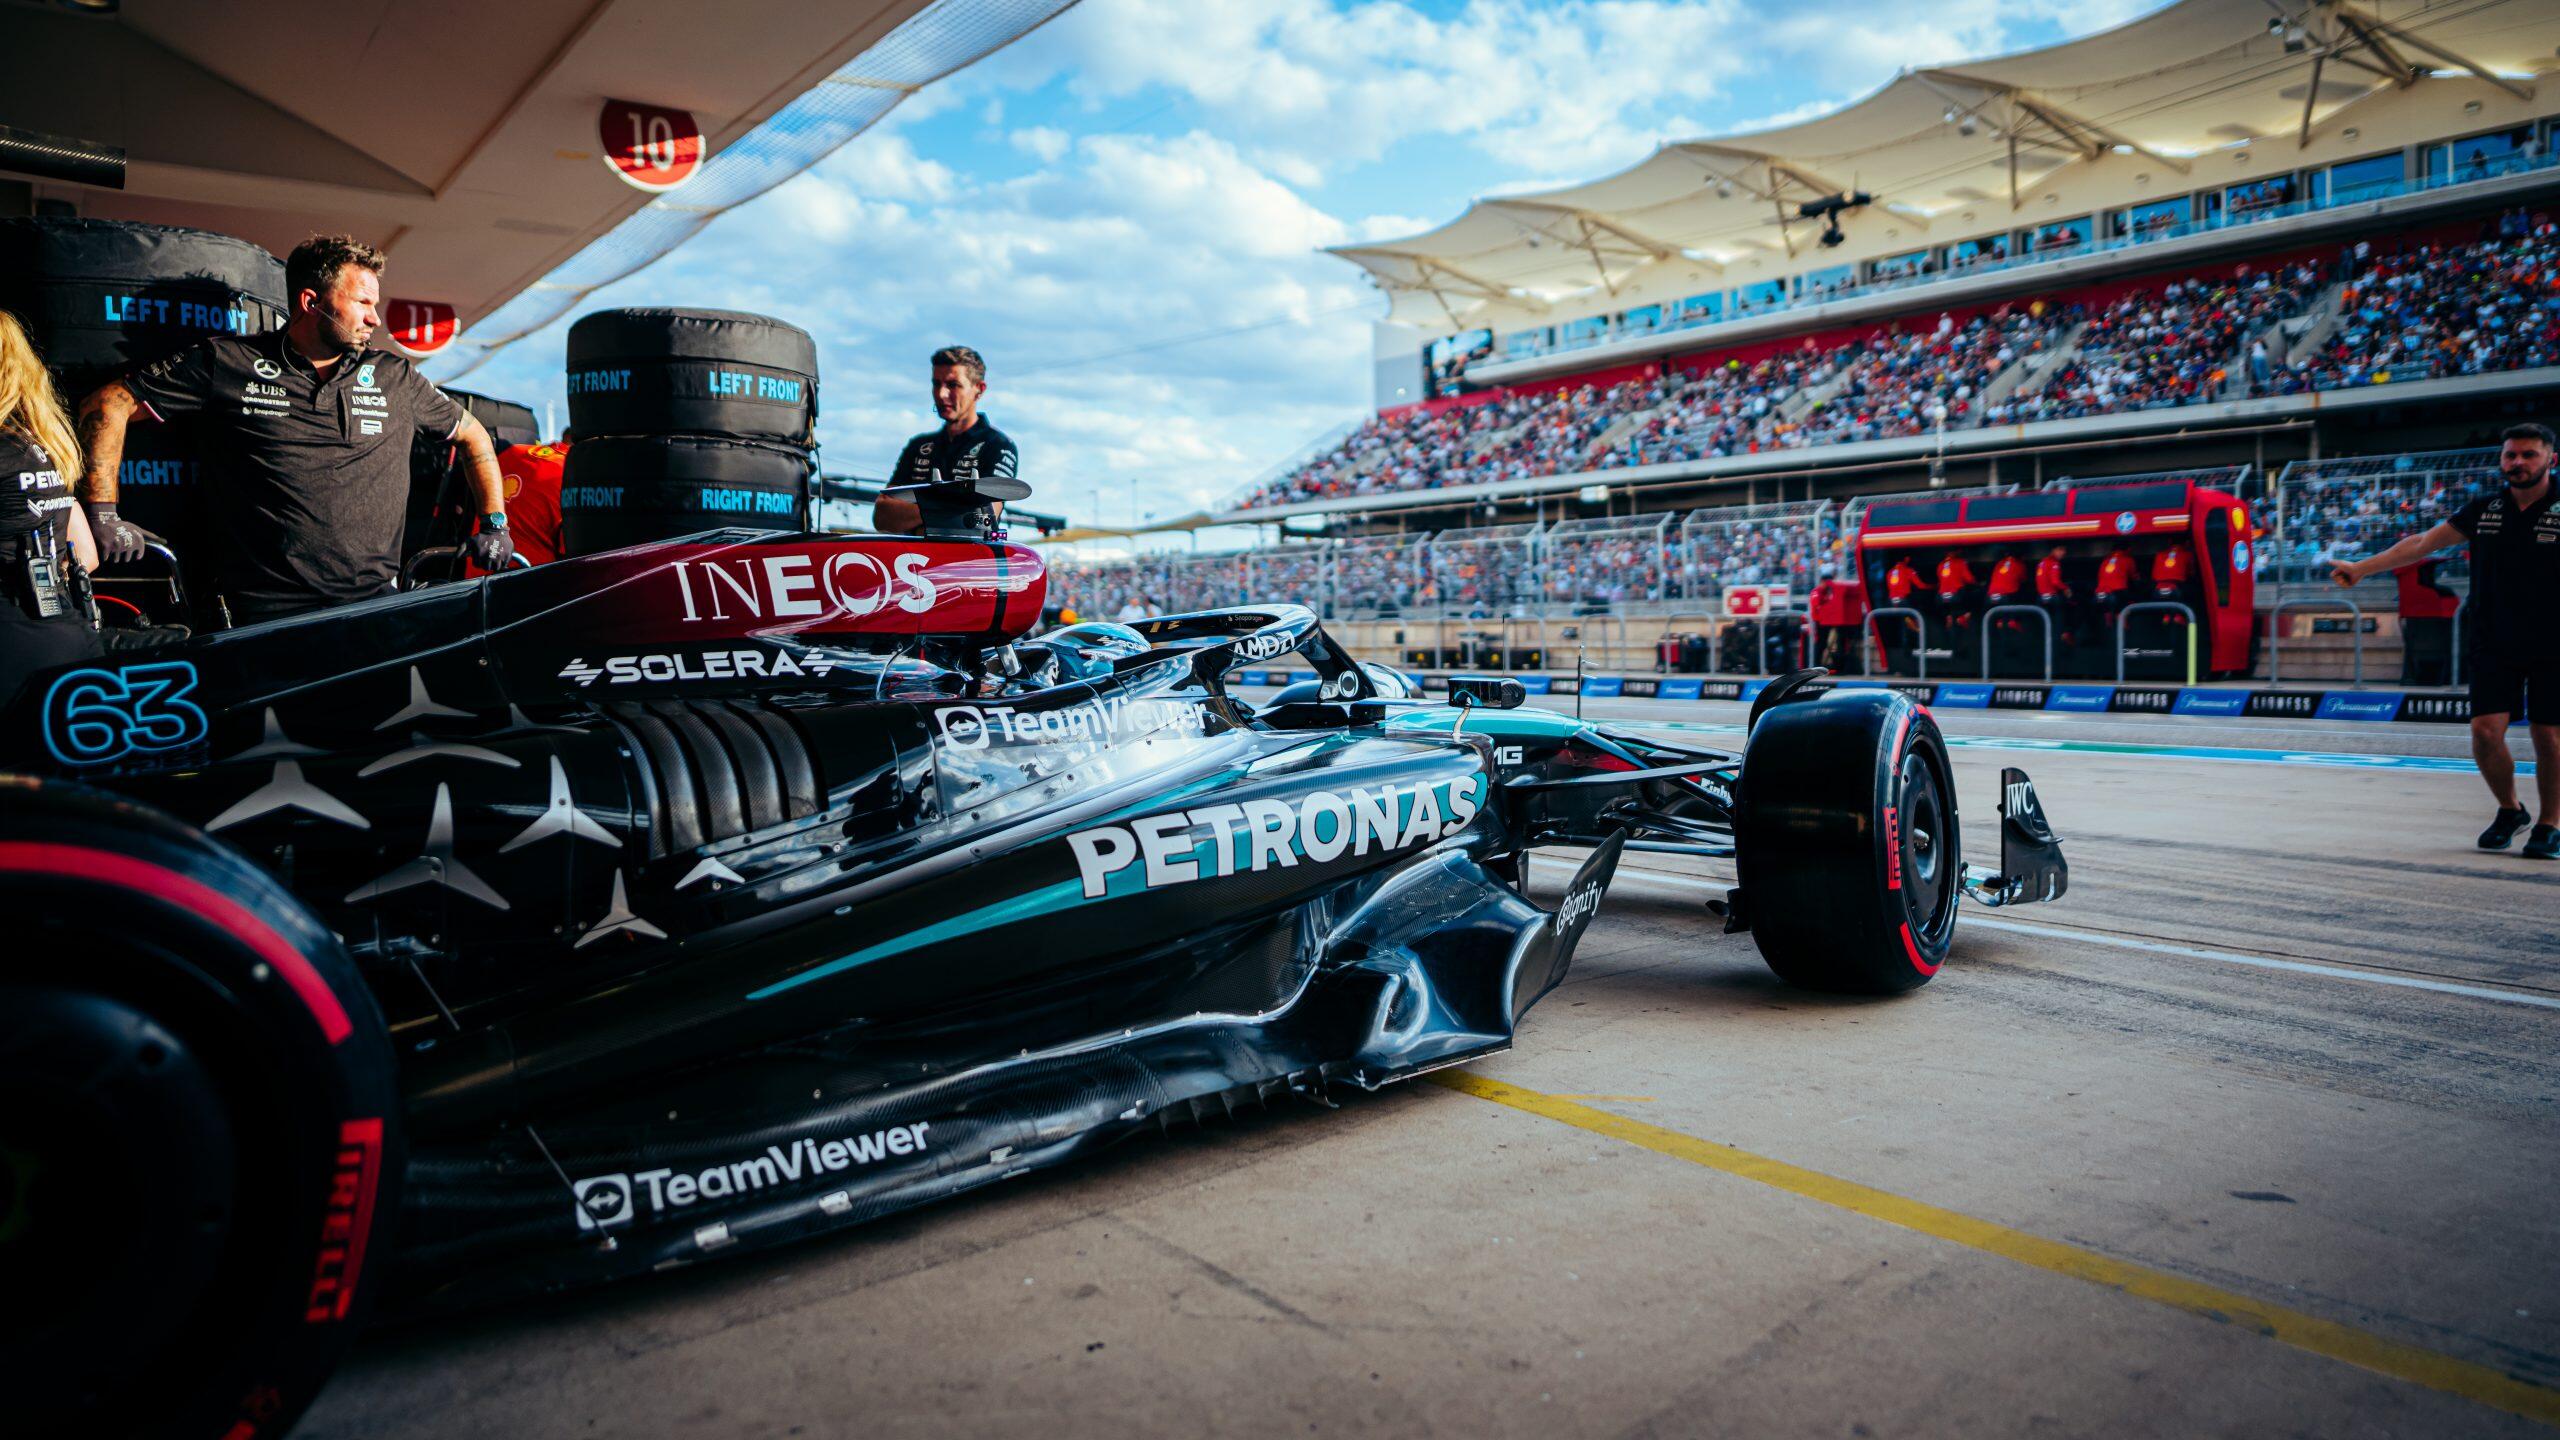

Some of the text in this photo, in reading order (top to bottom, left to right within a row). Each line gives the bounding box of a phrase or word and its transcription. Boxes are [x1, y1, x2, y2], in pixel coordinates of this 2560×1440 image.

[628, 112, 675, 172] 10
[105, 295, 248, 336] LEFT FRONT
[407, 304, 434, 343] 11
[261, 384, 287, 397] UBS
[584, 369, 631, 392] FRONT
[709, 370, 800, 402] LEFT FRONT
[352, 395, 387, 407] INEOS
[119, 460, 183, 485] RIGHT
[581, 487, 624, 508] FRONT
[702, 489, 793, 514] RIGHT FRONT
[671, 552, 937, 622] INEOS
[606, 648, 801, 684] SOLERA
[42, 661, 208, 765] 63
[984, 695, 1208, 742] TeamViewer
[2006, 781, 2033, 818] IWC
[1066, 775, 1479, 900] PETRONAS
[1883, 807, 1901, 889] PIRELLI
[635, 1121, 930, 1211] TeamViewer
[305, 1117, 384, 1322] PIRELLI
